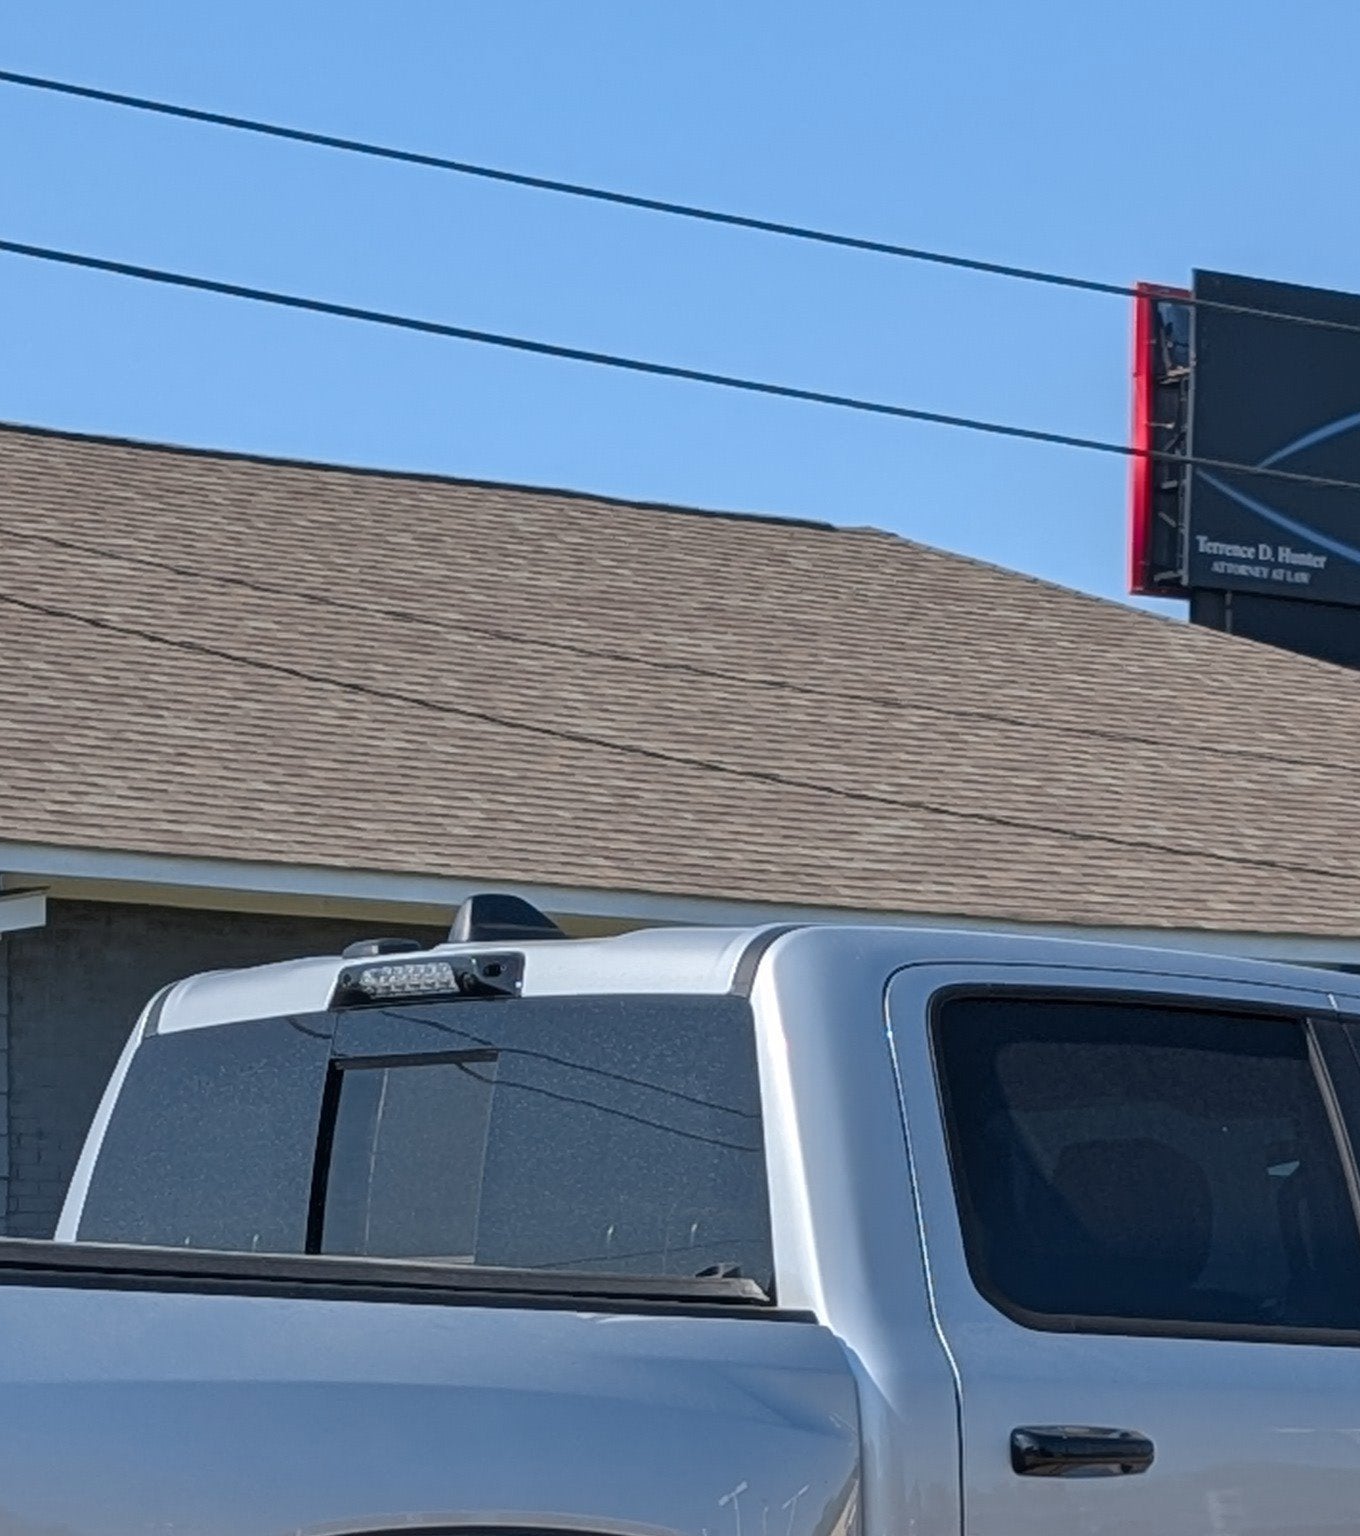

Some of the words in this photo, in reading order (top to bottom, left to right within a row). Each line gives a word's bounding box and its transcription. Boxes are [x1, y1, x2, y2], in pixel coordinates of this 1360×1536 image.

[1196, 535, 1256, 559] Terrence
[1258, 543, 1276, 562] D.
[1277, 545, 1328, 570] Hunter
